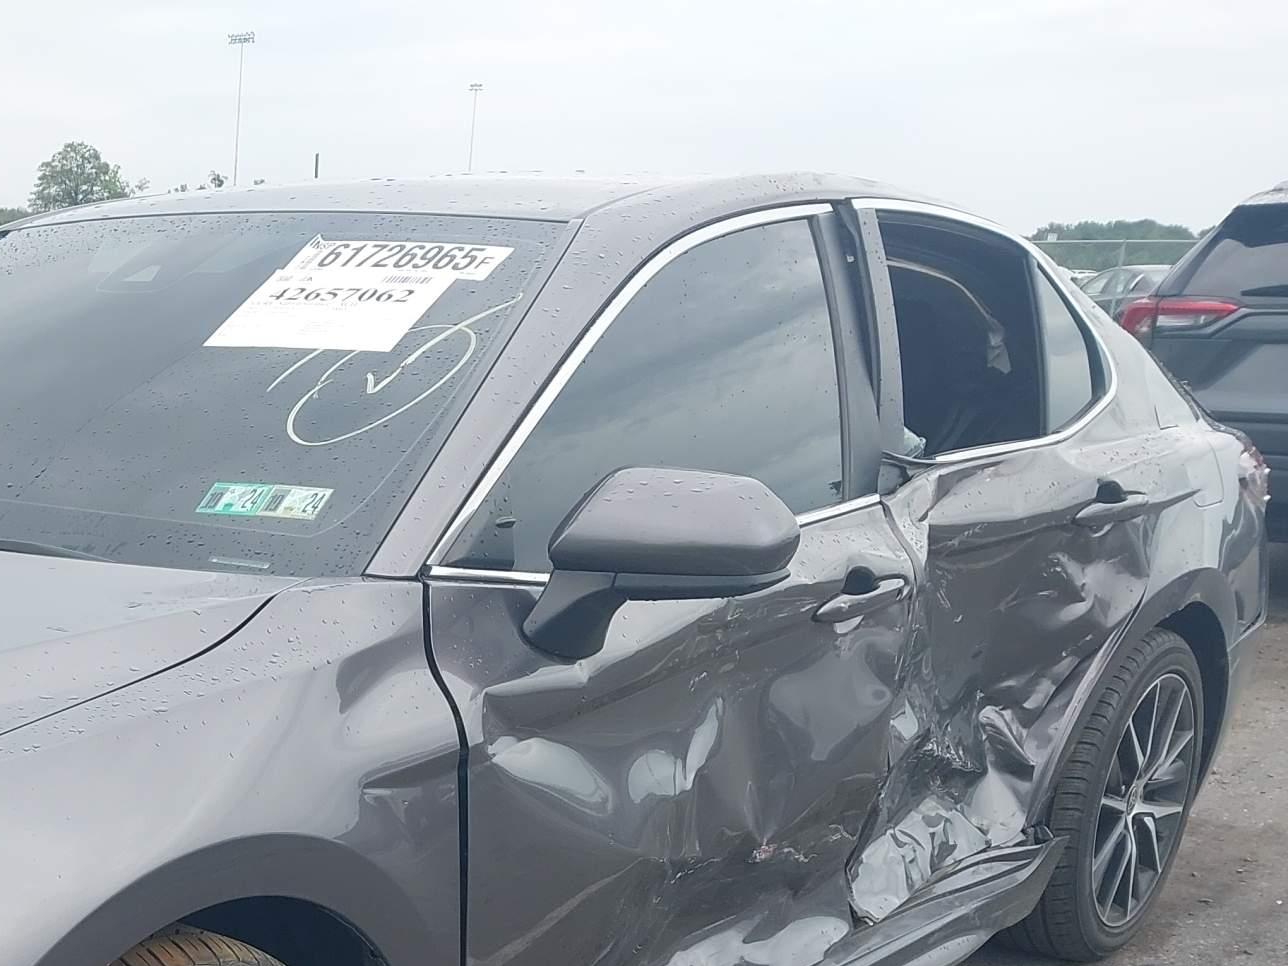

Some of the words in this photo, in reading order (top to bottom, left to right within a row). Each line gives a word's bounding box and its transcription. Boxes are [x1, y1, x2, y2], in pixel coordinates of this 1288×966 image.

[318, 243, 488, 271] 61726965
[269, 287, 415, 303] 42657062
[301, 492, 326, 515] 24
